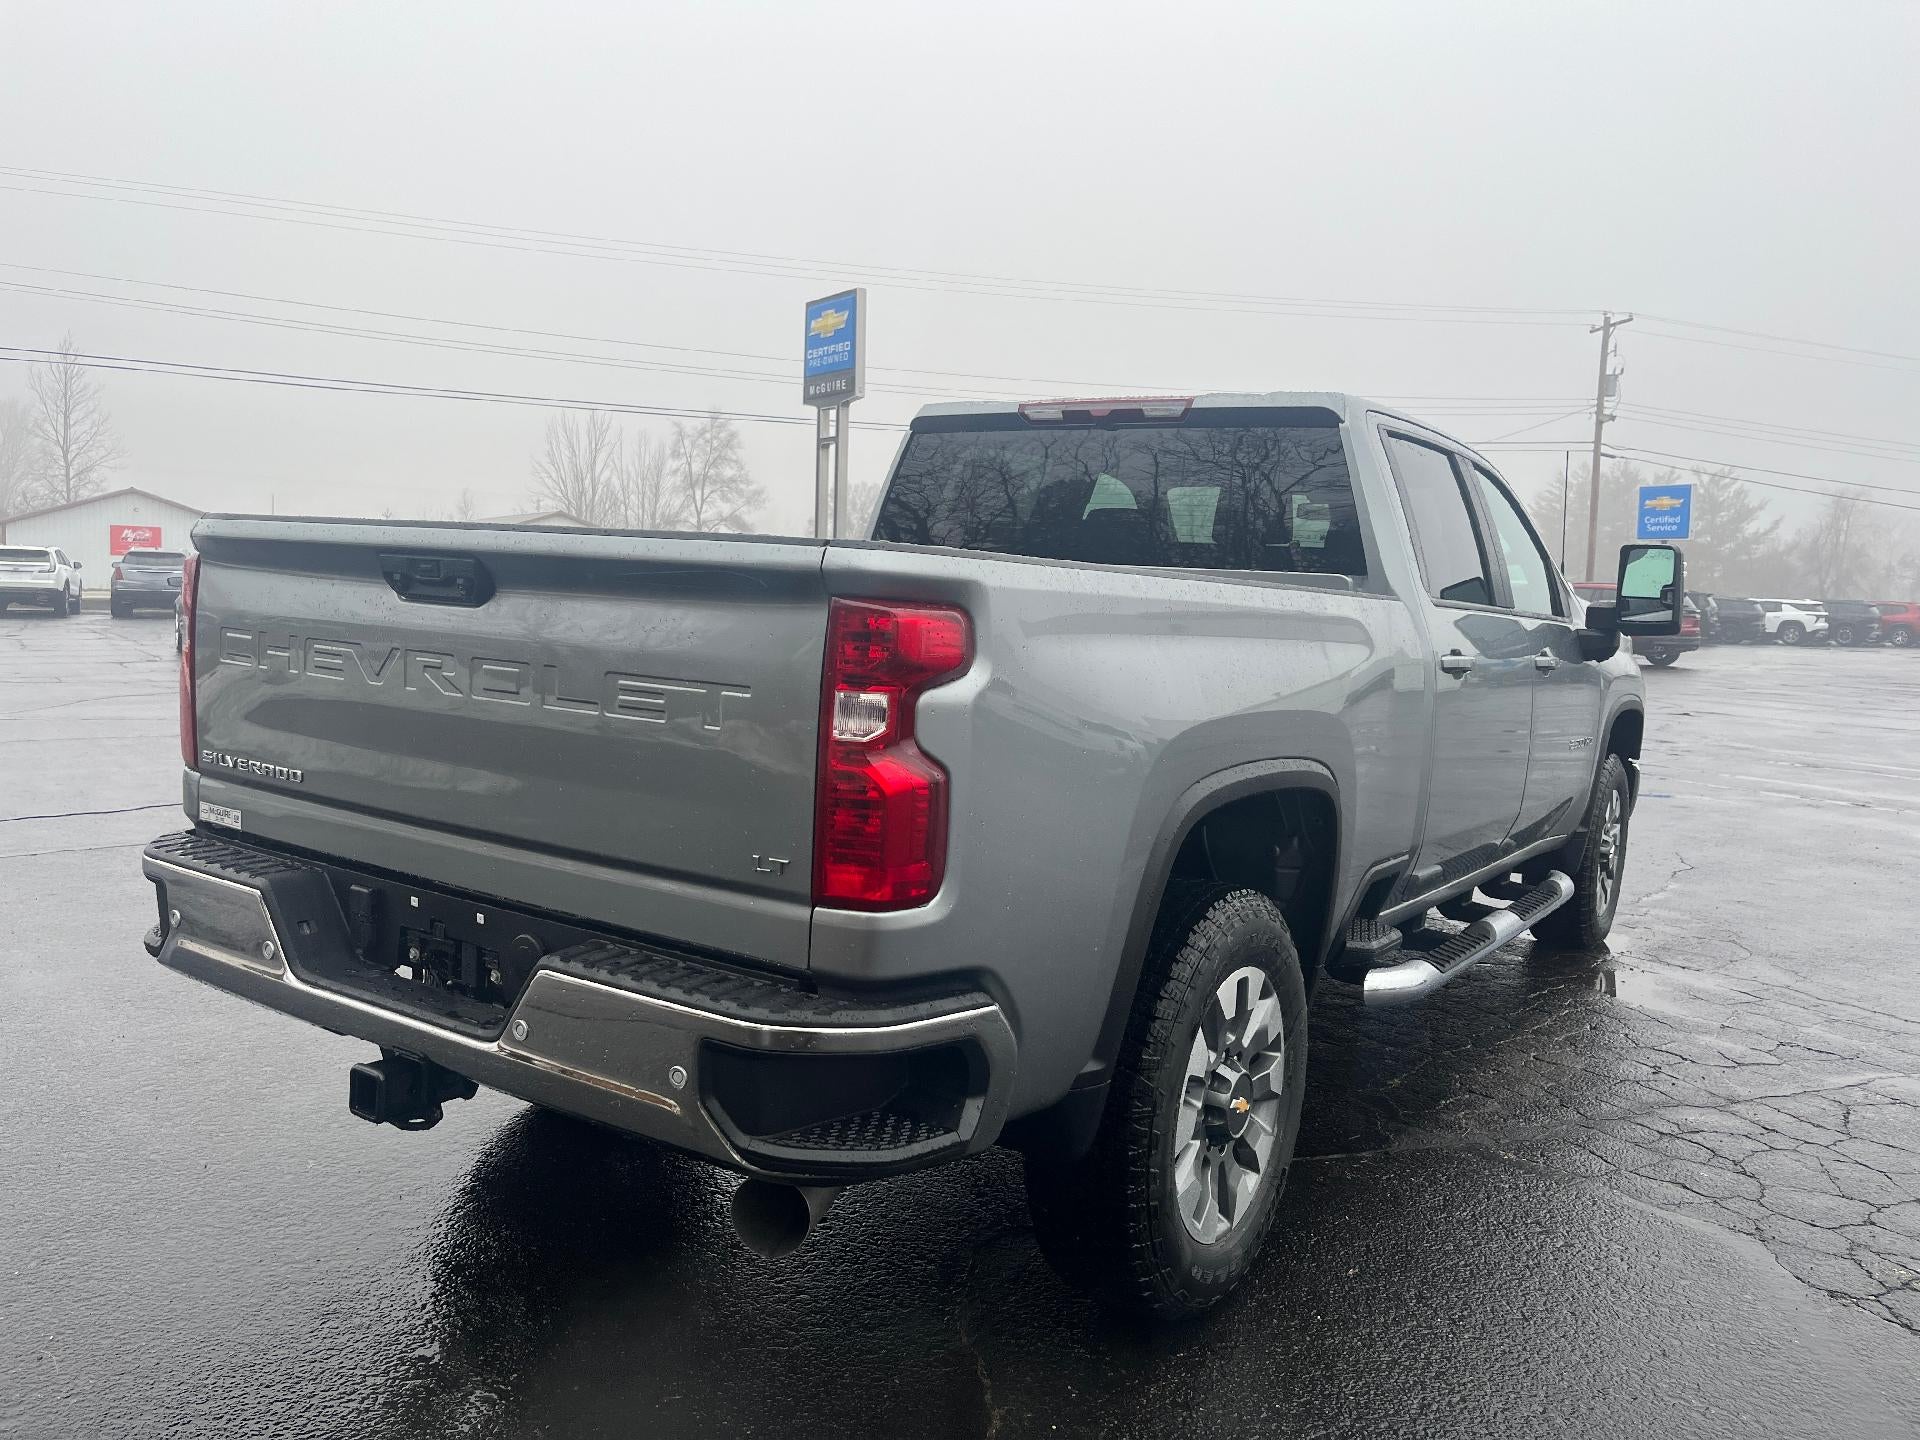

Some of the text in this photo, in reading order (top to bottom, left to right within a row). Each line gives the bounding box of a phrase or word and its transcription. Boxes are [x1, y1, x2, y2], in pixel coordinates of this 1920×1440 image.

[807, 341, 851, 359] CERTIFIED
[809, 352, 848, 367] PRE-OWNED
[809, 379, 847, 395] McGUIRE
[1644, 515, 1681, 524] Certified
[1646, 524, 1678, 532] Service
[219, 626, 752, 730] CHEVROLET
[202, 749, 304, 784] SILVERADO
[752, 854, 791, 878] LT
